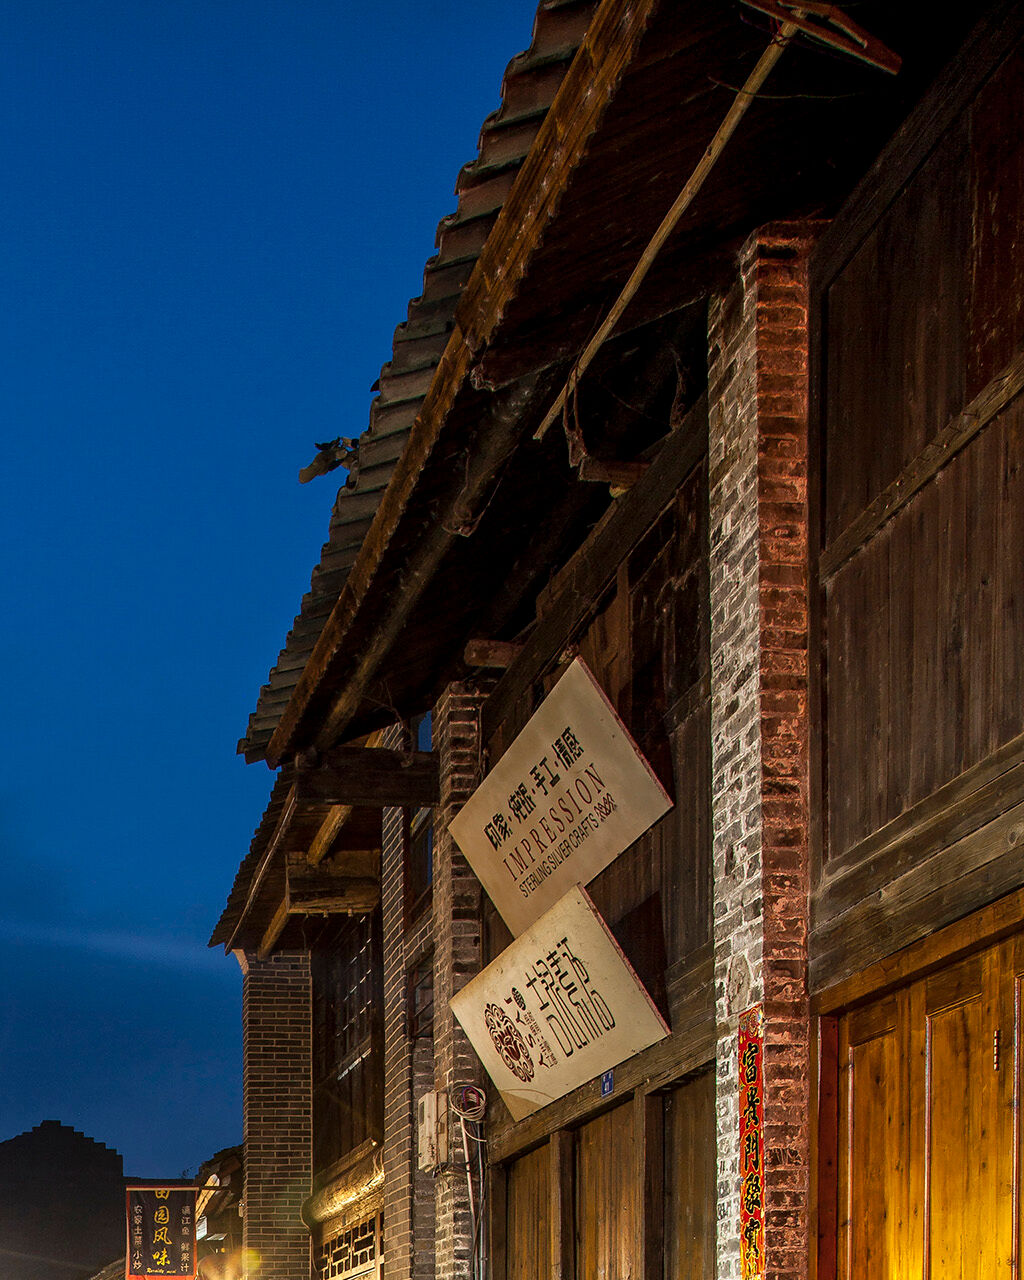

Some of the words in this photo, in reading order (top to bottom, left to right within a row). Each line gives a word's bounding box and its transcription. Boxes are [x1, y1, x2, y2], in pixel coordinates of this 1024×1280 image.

[503, 762, 606, 881] IMPRESSION
[519, 860, 553, 898] STERLING
[547, 842, 575, 875] SILVER
[570, 812, 600, 849] CRAFTS
[152, 1190, 173, 1266] 田园风味
